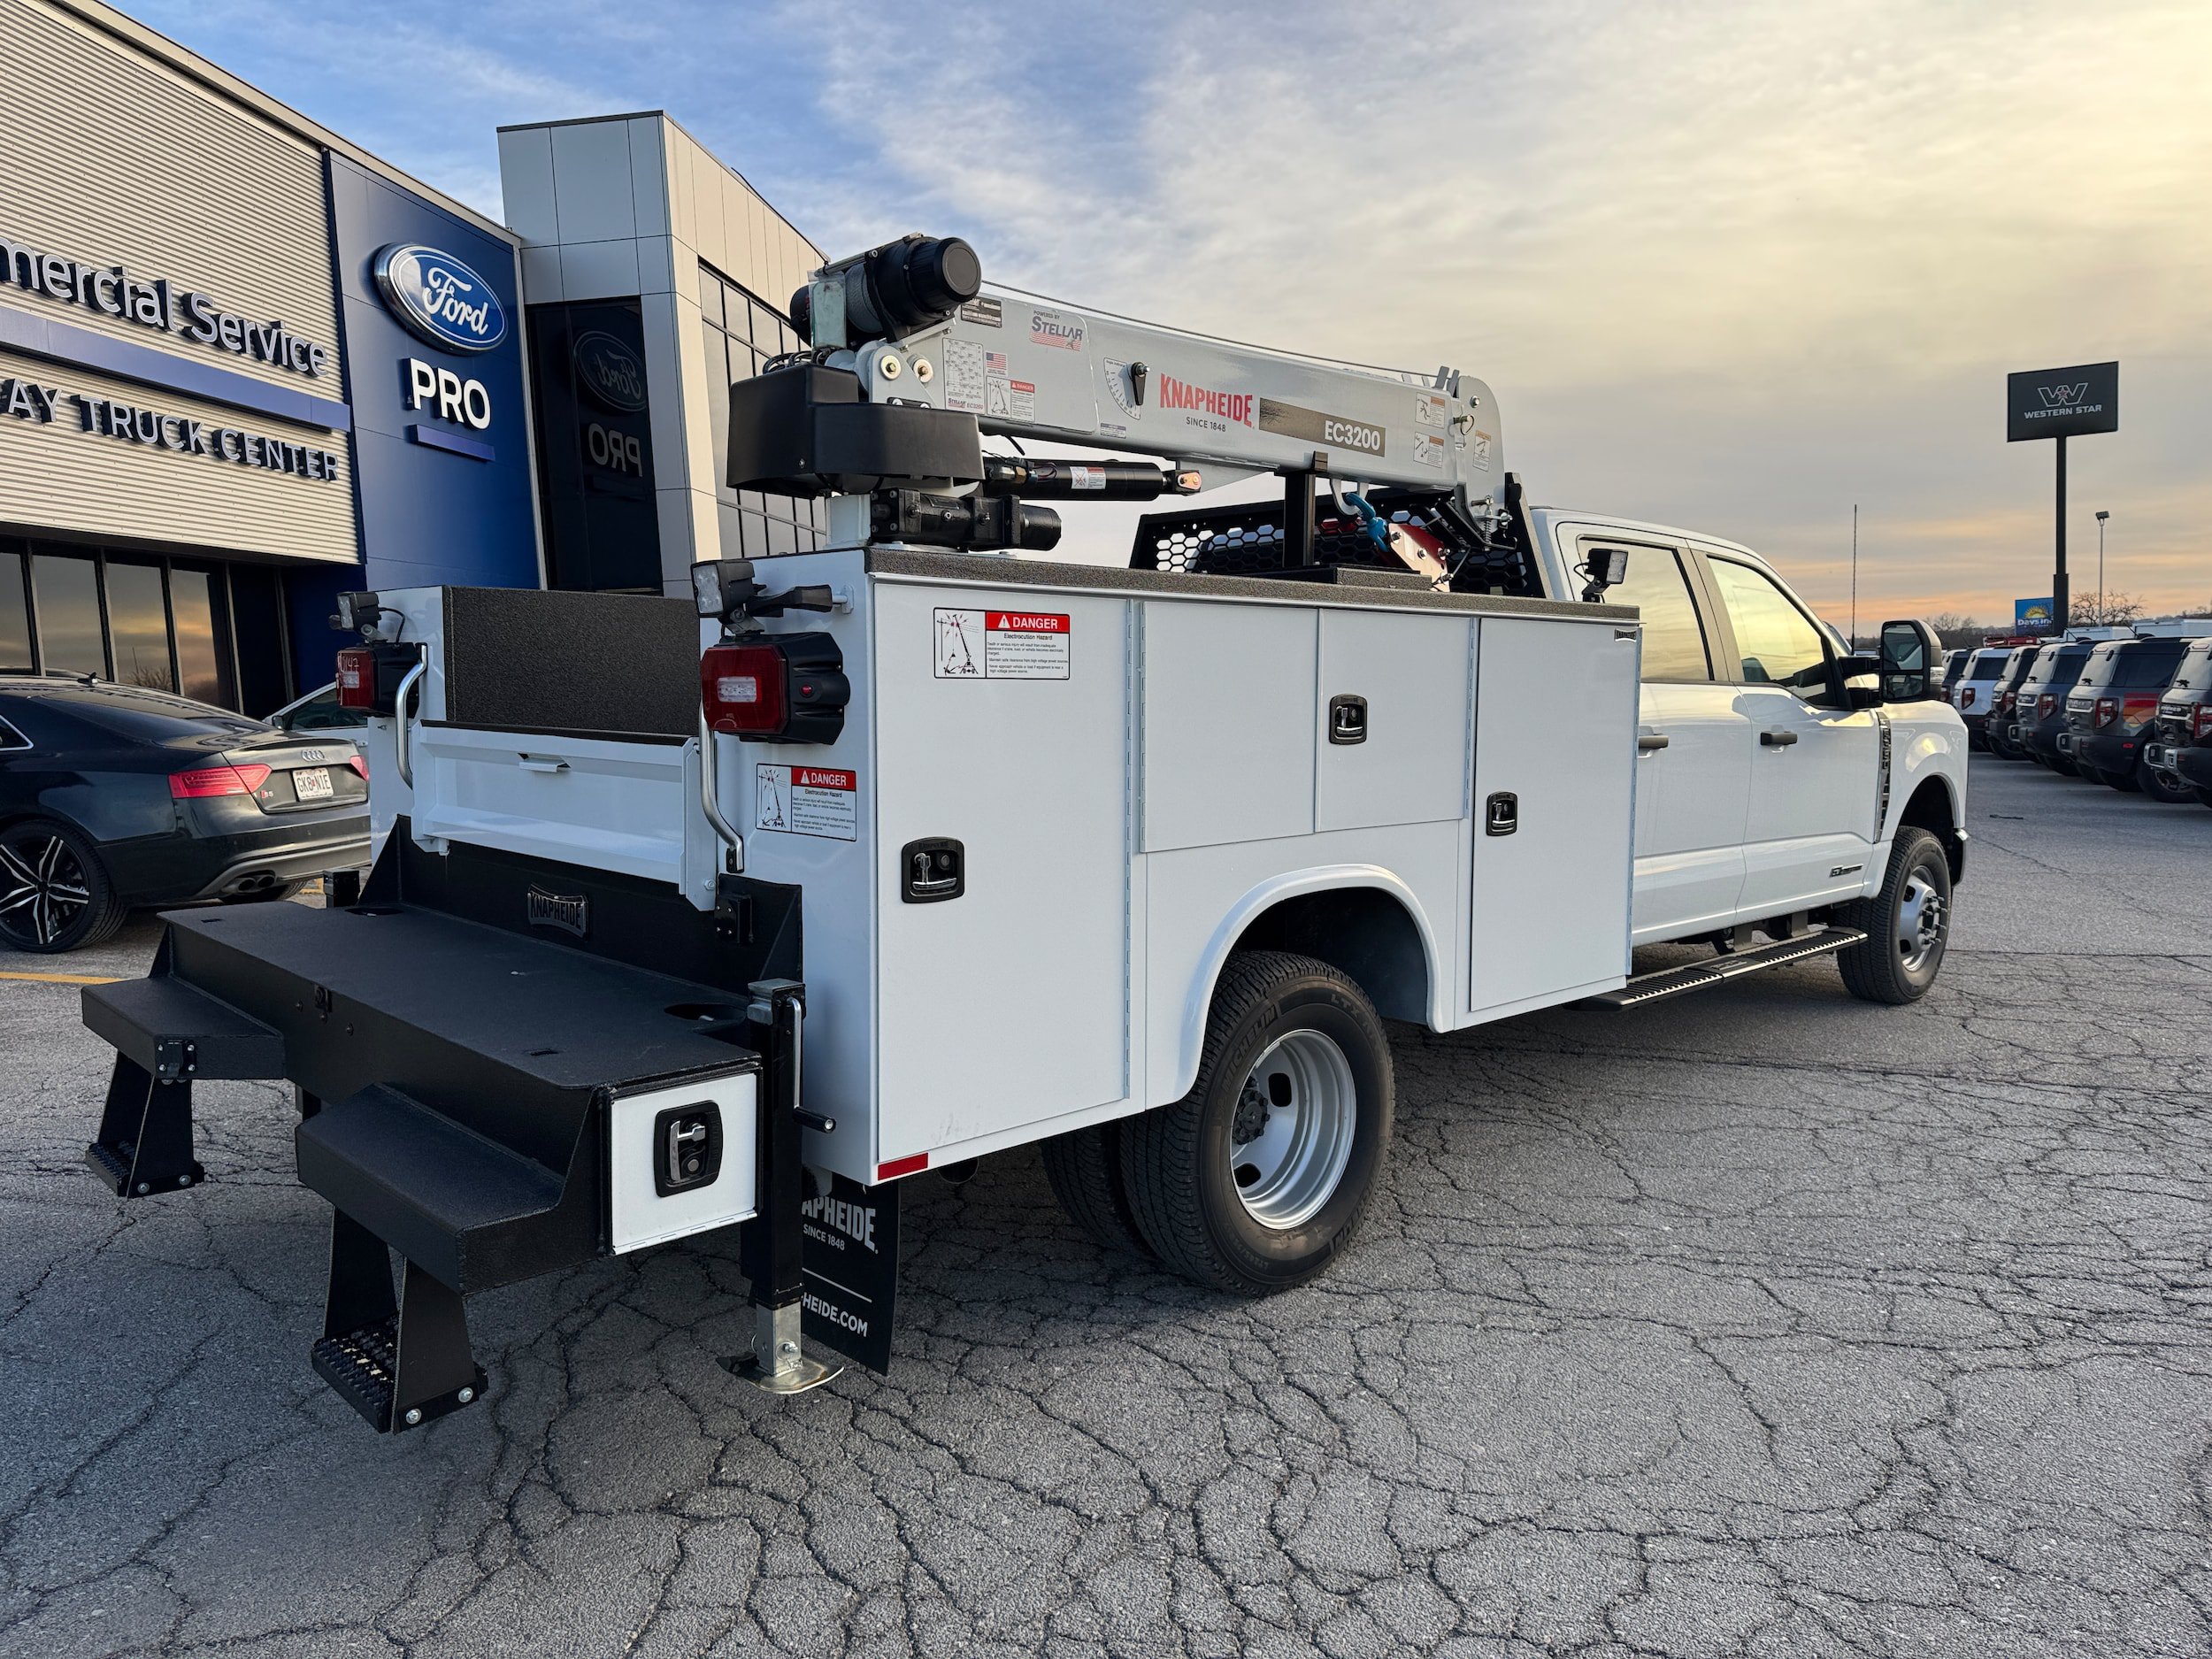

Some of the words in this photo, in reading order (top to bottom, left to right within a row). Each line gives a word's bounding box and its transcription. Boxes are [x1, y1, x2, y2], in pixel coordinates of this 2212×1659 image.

[422, 266, 489, 335] Ford
[1033, 310, 1053, 319] POWERED
[188, 292, 328, 378] Service
[1032, 315, 1083, 342] STELLAR
[410, 357, 491, 430] PRO
[1160, 373, 1253, 427] KNAPHEIDE
[1186, 416, 1209, 429] SINCE
[1210, 419, 1226, 433] 1848
[2024, 407, 2073, 419] WESTERN
[2076, 404, 2102, 414] STAR
[8, 378, 63, 423] AY
[78, 395, 209, 455] TRUCK
[219, 427, 339, 482] CENTER
[1325, 419, 1381, 451] EC3200
[1012, 617, 1058, 630] DANGER
[296, 776, 313, 793] GK8
[811, 772, 847, 786] DANGER
[531, 891, 581, 931] KNAPHEIDE
[1331, 993, 1360, 1018] LTX
[1222, 1004, 1278, 1092] MICHELIN
[803, 1223, 826, 1242] SINCE
[827, 1233, 845, 1251] 1848
[802, 1292, 868, 1337] HEIDE.COM
